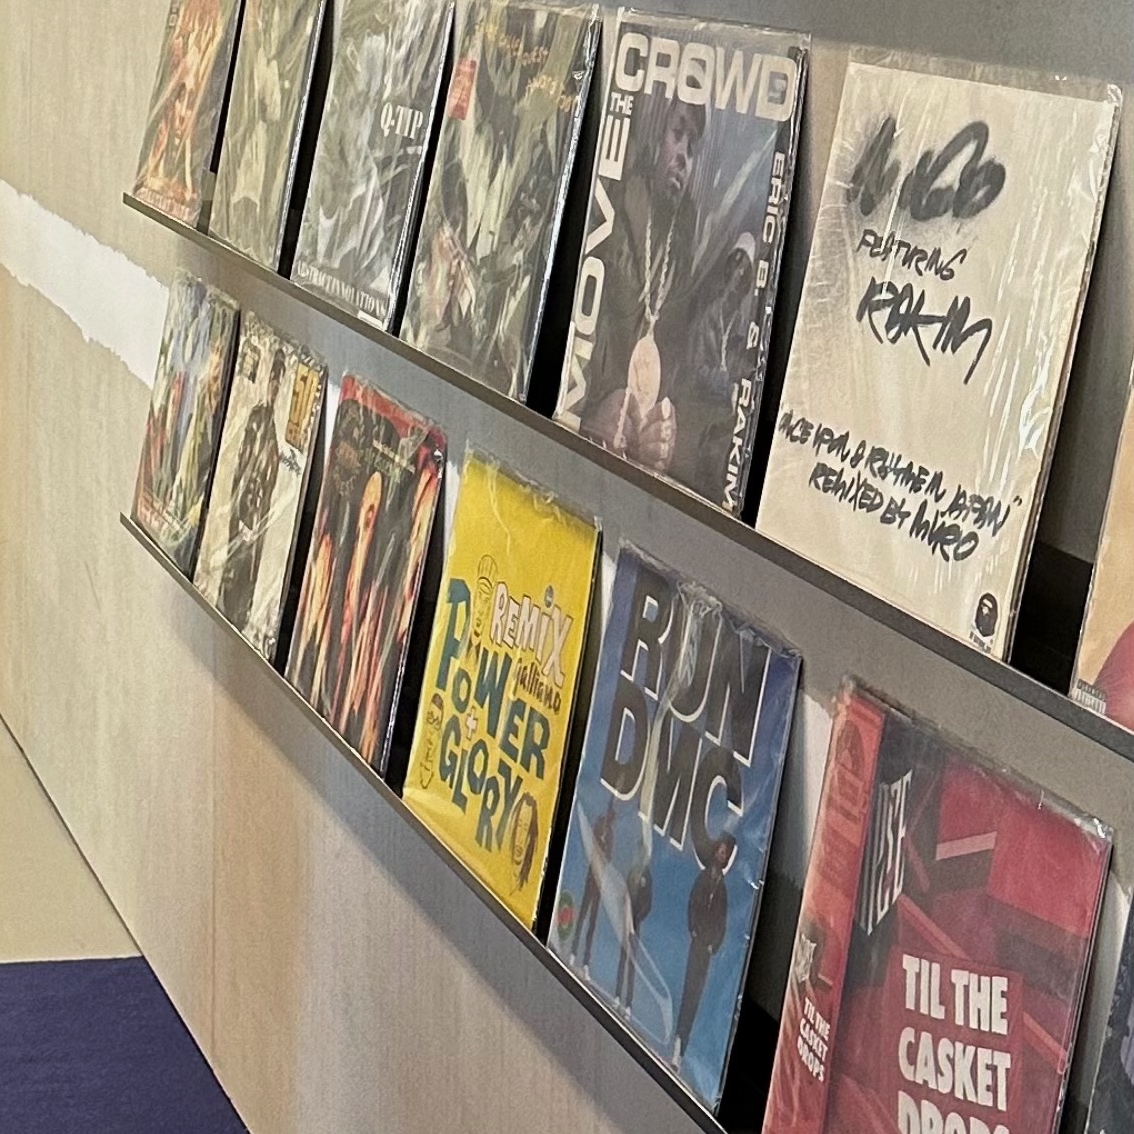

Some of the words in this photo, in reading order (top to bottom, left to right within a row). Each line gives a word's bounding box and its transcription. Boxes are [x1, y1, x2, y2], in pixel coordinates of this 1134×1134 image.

[609, 90, 634, 117] THE
[614, 32, 797, 123] CROWD
[761, 151, 786, 244] ERIC
[552, 116, 632, 432] MOVE
[721, 377, 753, 512] RAKIM
[620, 572, 772, 768] RUN
[438, 713, 525, 853] GLORY
[599, 680, 746, 879] DMC
[902, 953, 946, 1021] TIL
[950, 969, 1009, 1036] THE
[898, 1026, 1012, 1113] CASKET
